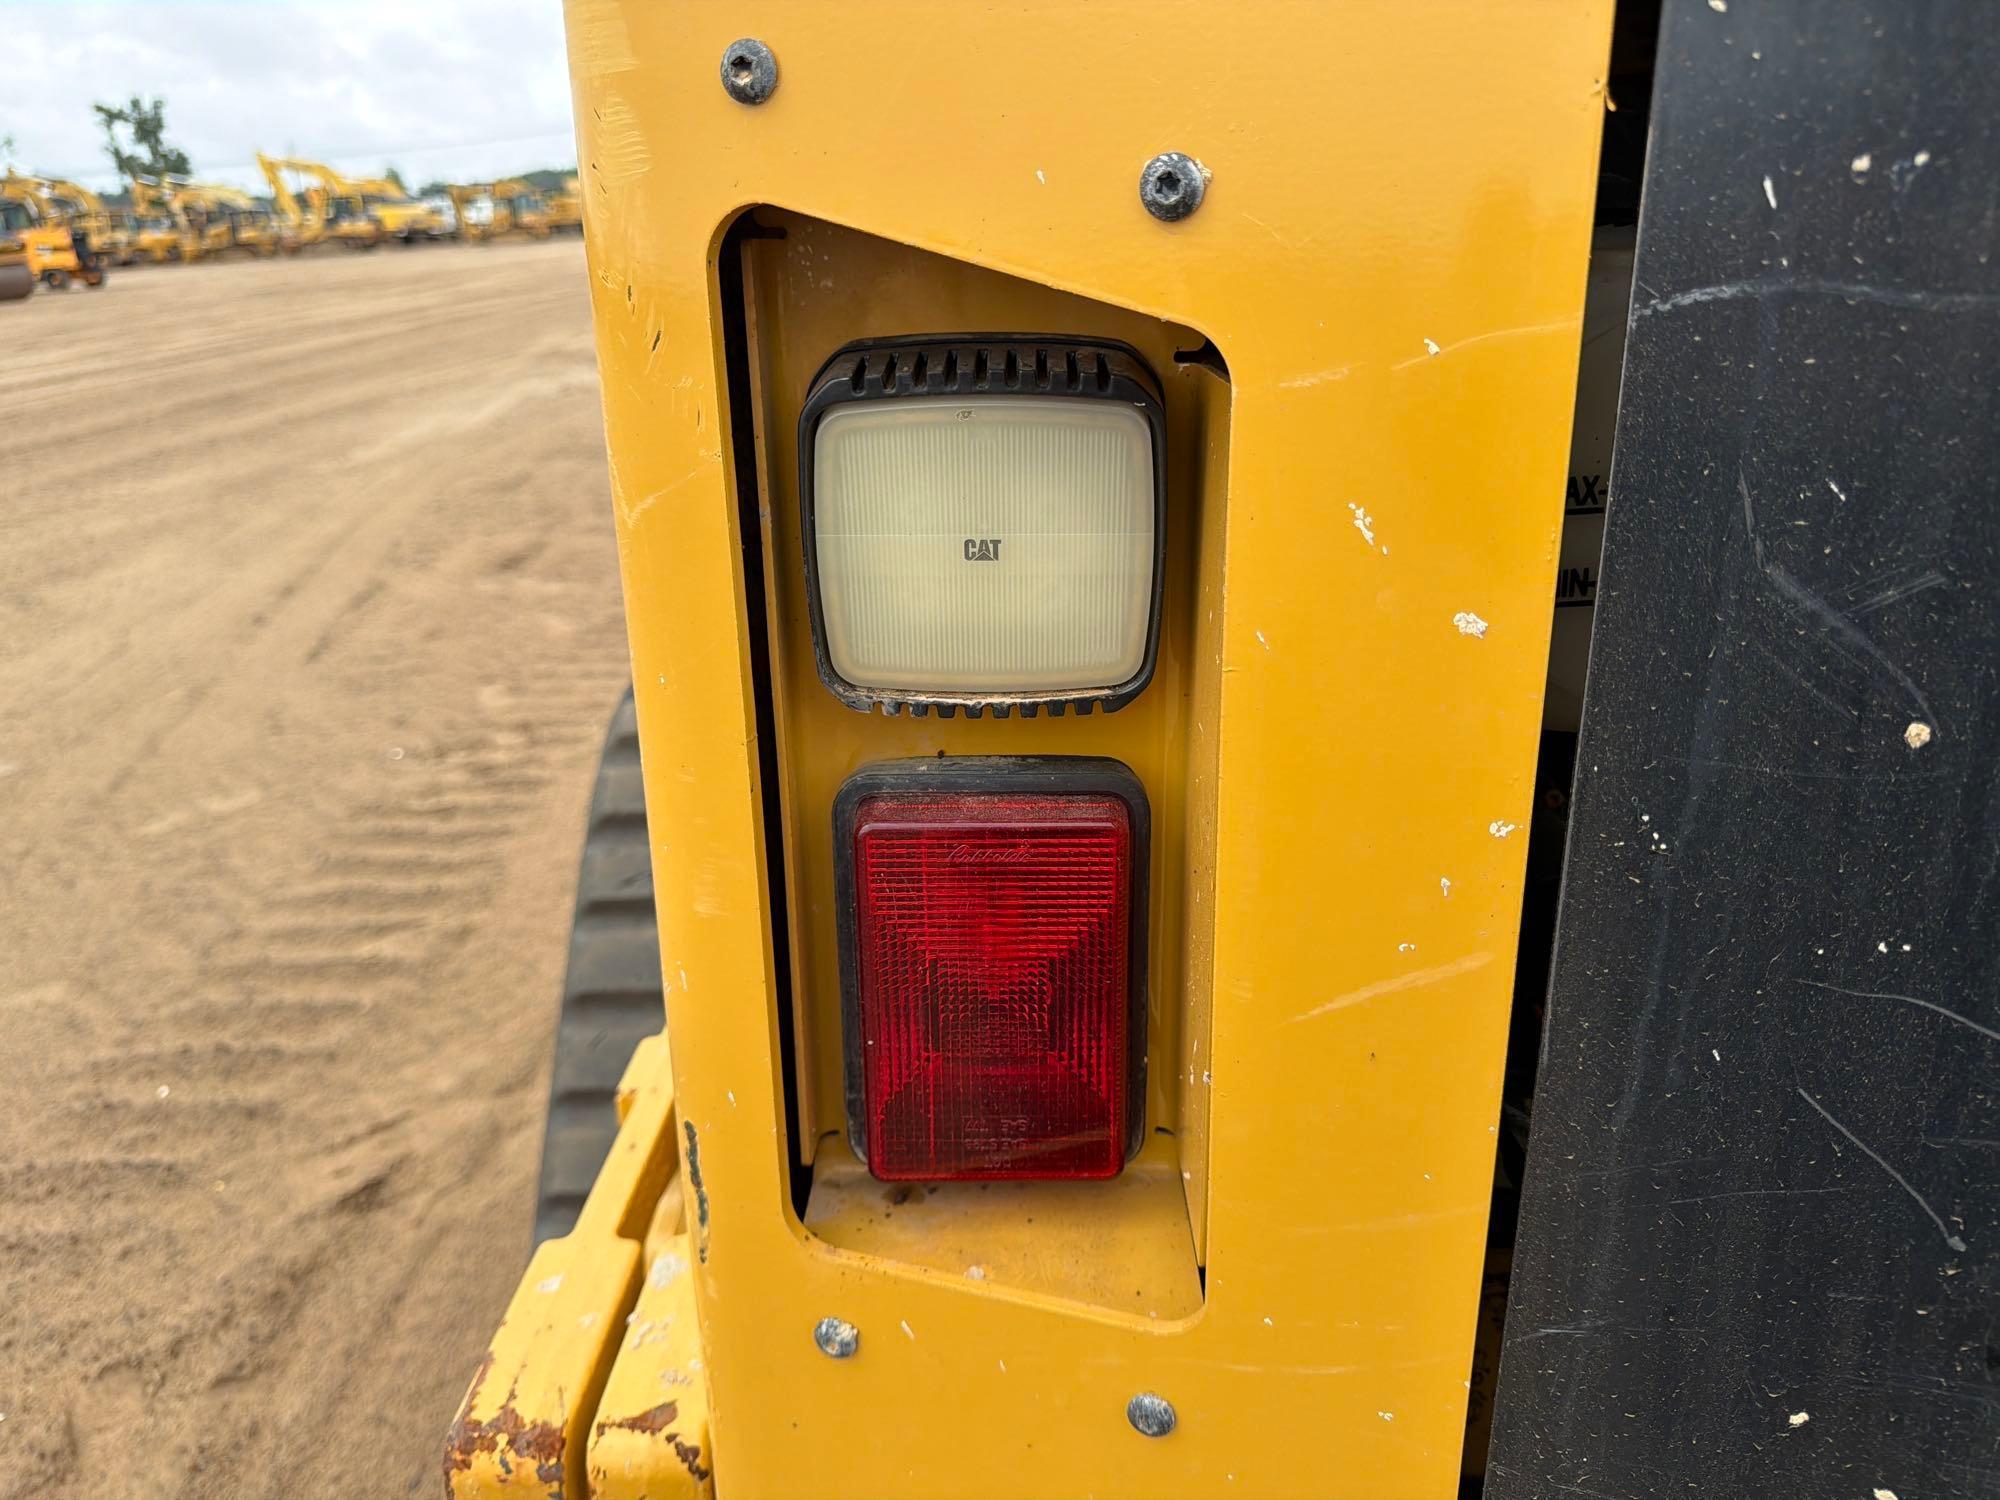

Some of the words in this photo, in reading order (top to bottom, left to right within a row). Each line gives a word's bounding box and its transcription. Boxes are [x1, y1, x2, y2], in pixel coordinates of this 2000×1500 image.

[1565, 475, 1607, 506] AX-
[964, 539, 1001, 561] CAT
[1556, 567, 1597, 598] IN-
